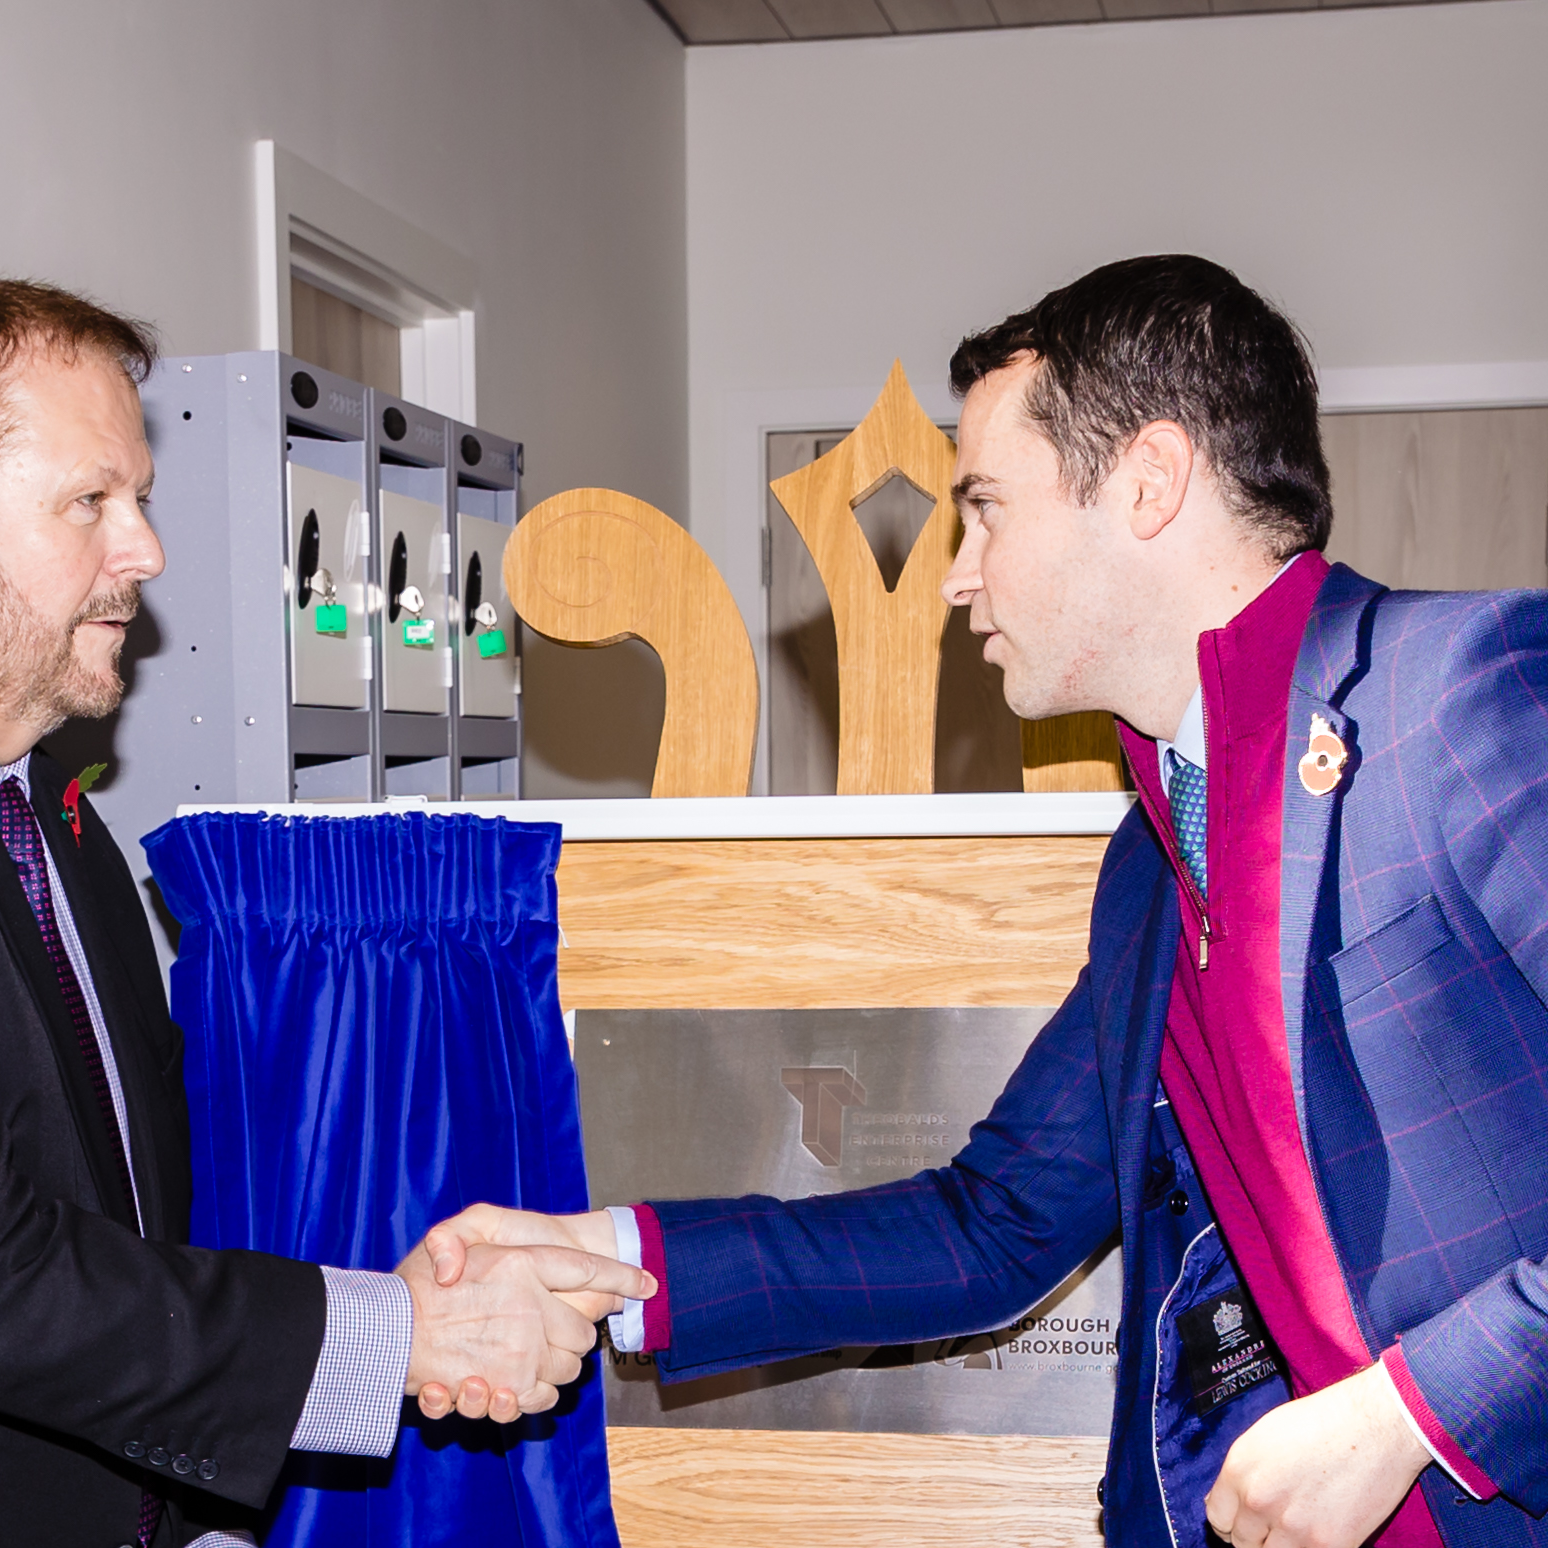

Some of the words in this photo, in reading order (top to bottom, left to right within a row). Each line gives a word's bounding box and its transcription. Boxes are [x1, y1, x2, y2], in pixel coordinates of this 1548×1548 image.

[851, 1113, 950, 1126] THEOBALDS
[849, 1134, 950, 1147] ENTERPRISE
[865, 1156, 932, 1168] CENTRE
[1009, 1317, 1110, 1333] BOROUGH
[1211, 1379, 1238, 1404] LEWIS
